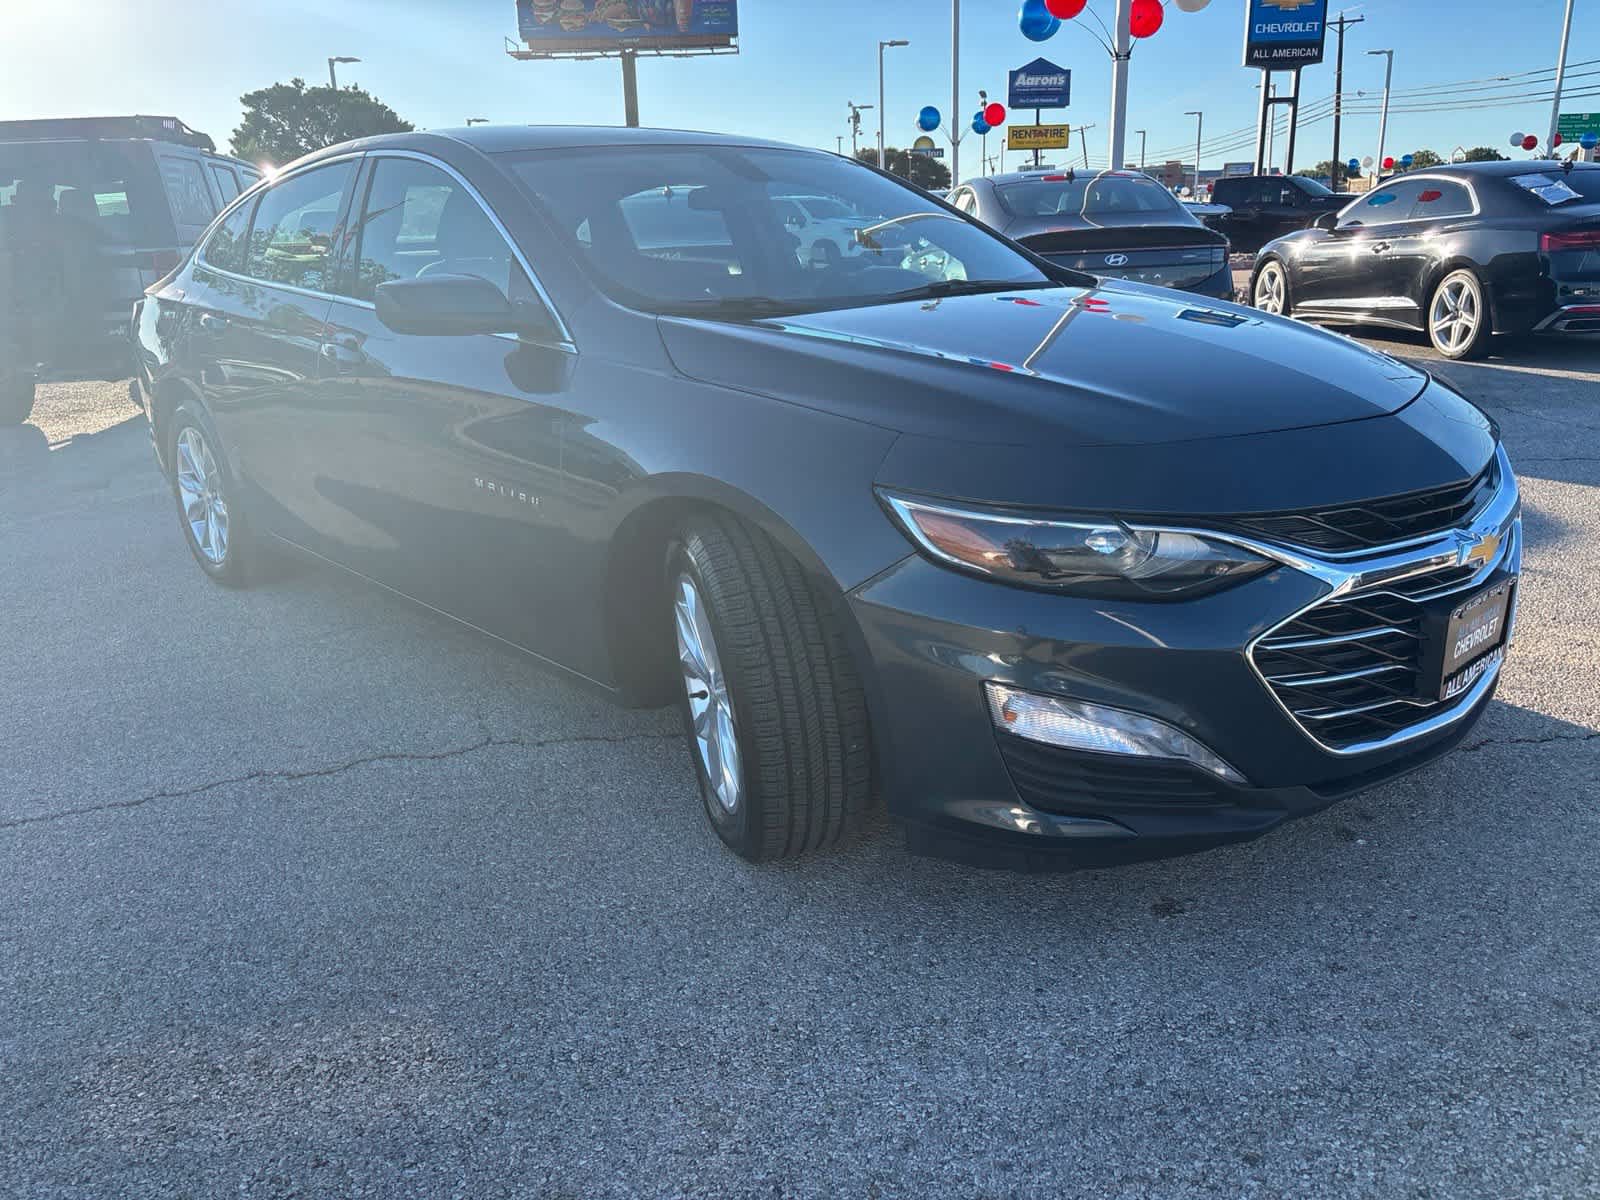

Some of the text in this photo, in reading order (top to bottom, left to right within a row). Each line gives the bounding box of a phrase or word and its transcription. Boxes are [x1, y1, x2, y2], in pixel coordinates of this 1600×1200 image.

[1255, 22, 1320, 33] CHEVROLET
[1253, 47, 1318, 58] ALL AMERICAN
[1015, 73, 1065, 86] Aaron's
[1454, 617, 1499, 659] CHEVROLET
